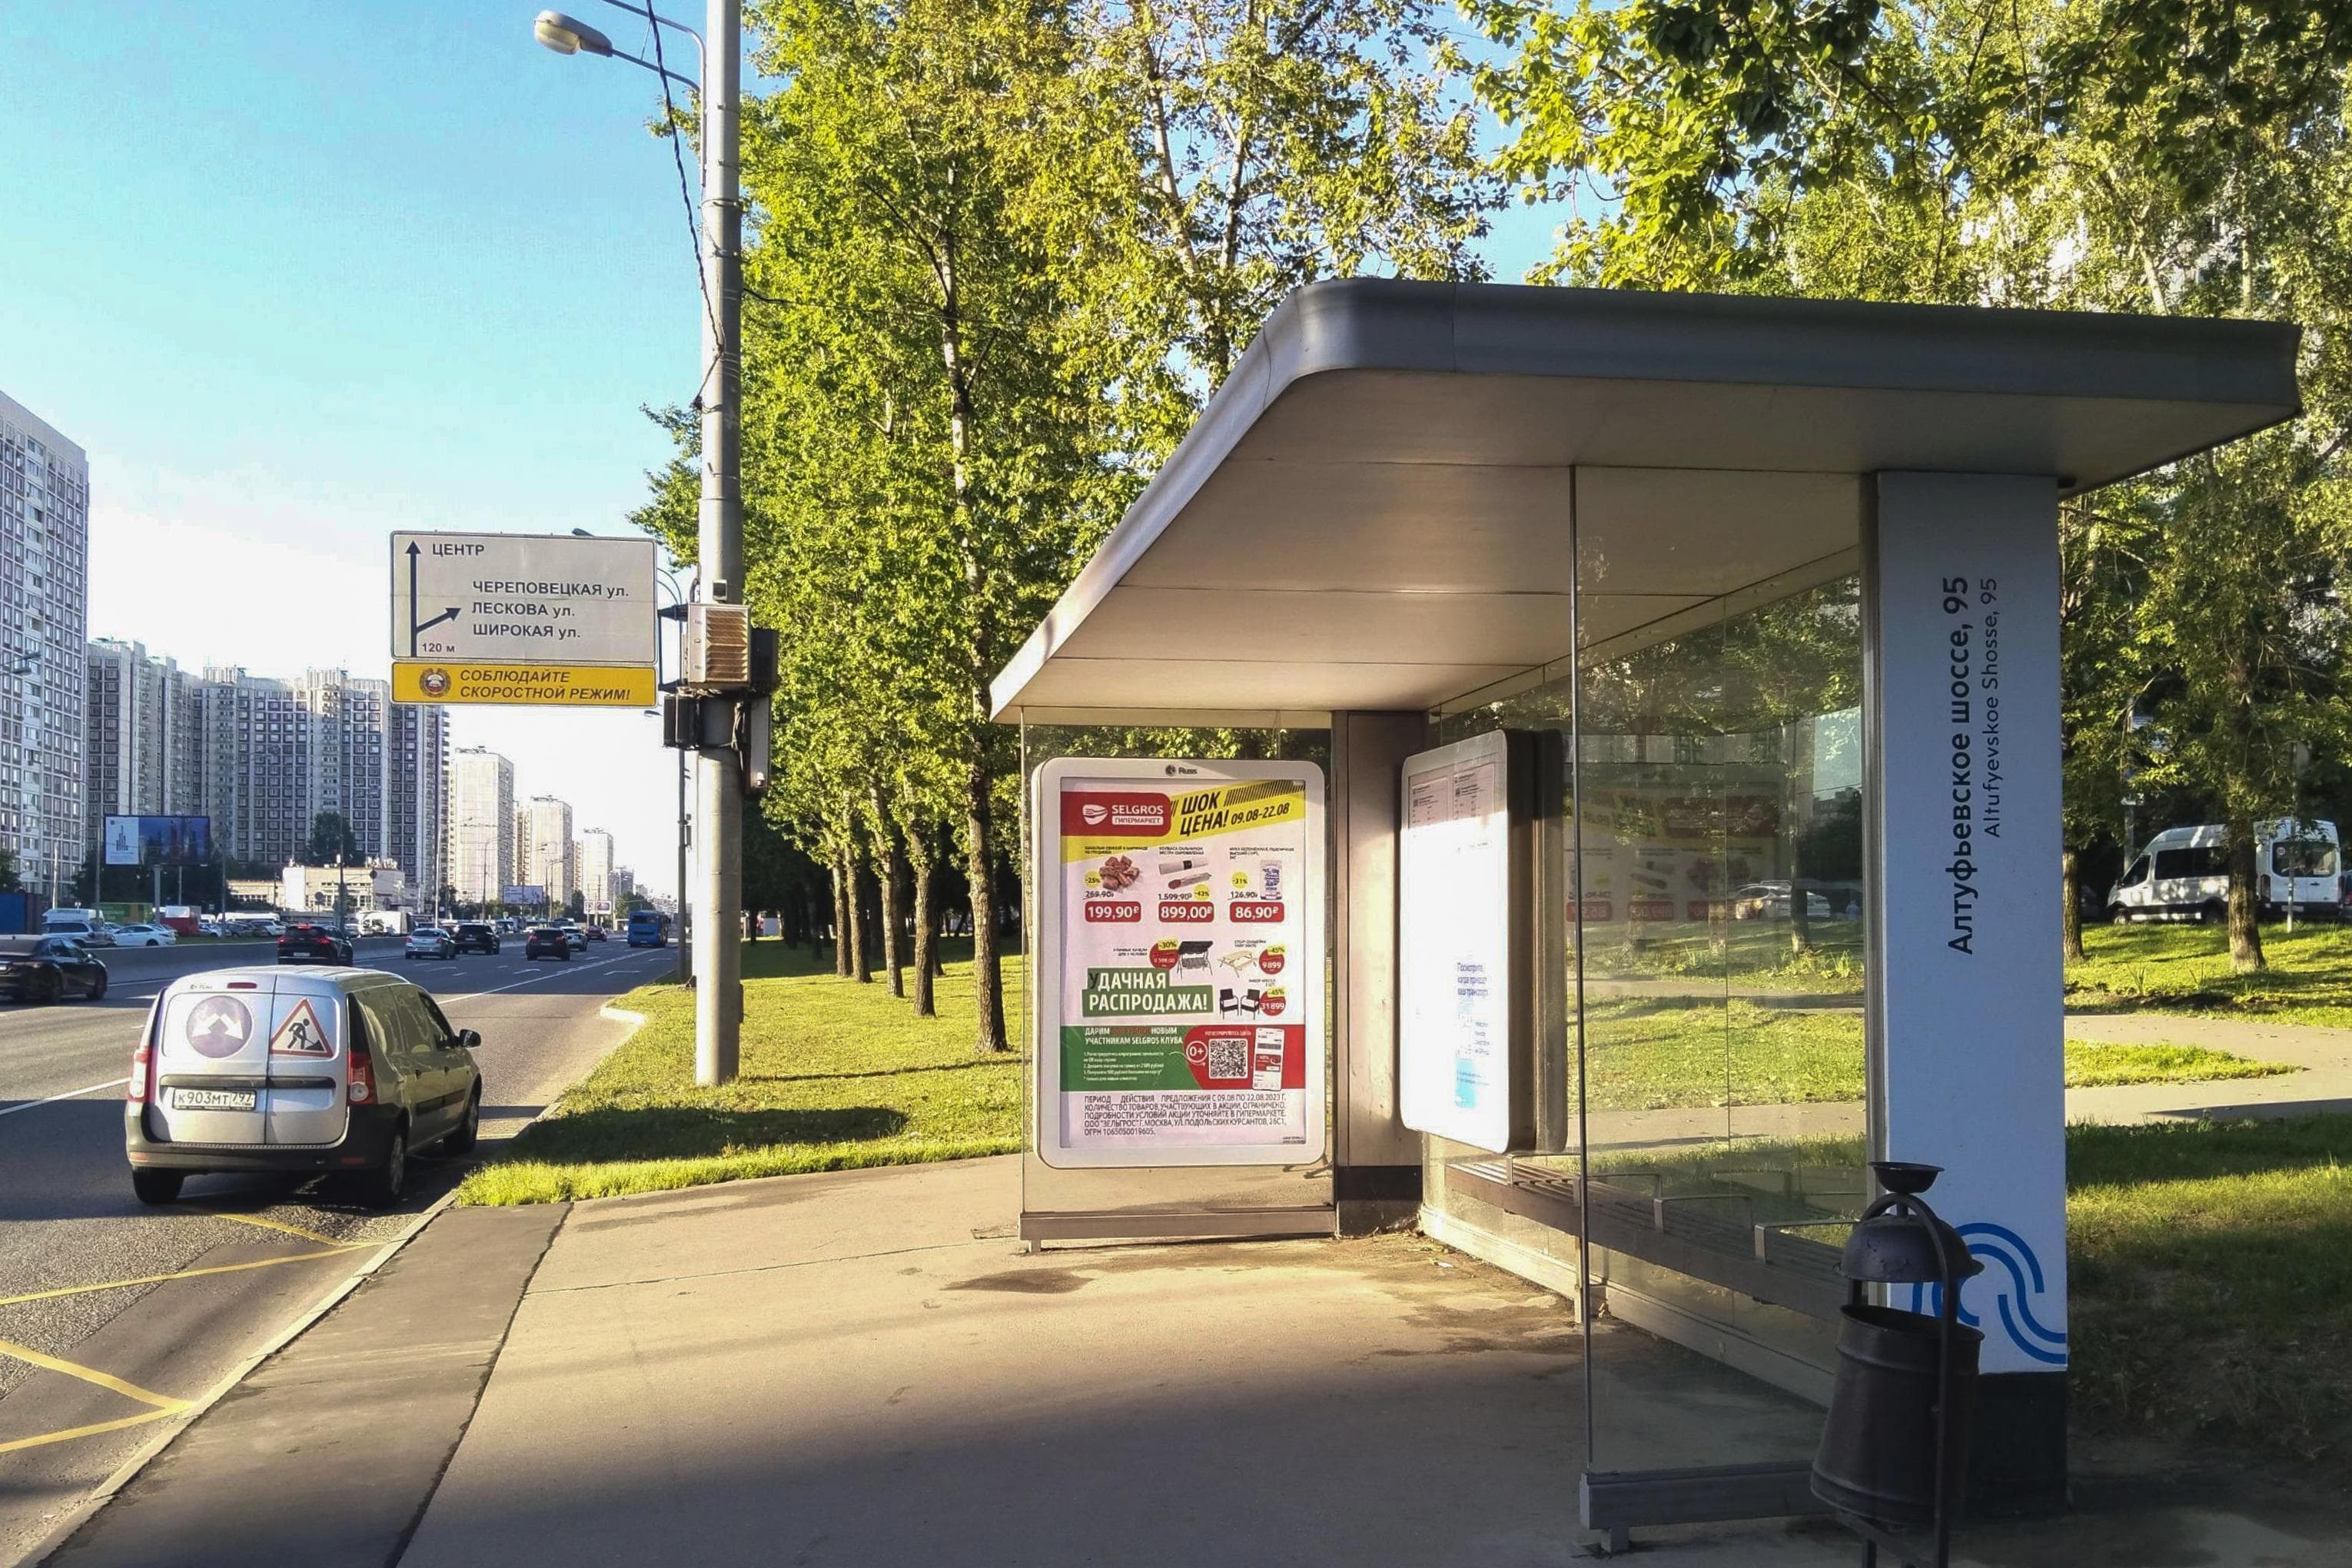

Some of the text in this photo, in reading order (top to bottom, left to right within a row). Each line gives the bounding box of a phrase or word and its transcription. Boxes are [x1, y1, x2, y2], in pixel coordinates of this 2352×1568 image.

[432, 543, 485, 556] ЦЕНТР
[473, 581, 630, 599] ЧЕРЕПОВЕЦКАЯ ул.
[472, 602, 576, 619] ЛЕСКОВА ул.
[473, 624, 581, 640] ШИРОКАЯ ул.
[422, 643, 443, 653] 120
[460, 669, 571, 684] СОБЛЮДАЙТЕ
[460, 684, 631, 700] СКОРОСТНОЙ РЕЖИМ!
[1980, 578, 2003, 839] Altufyevskoe Shosse, 95
[1943, 576, 1978, 955] Алтуфьевское шоссе, 95
[1111, 805, 1164, 815] SELGROS
[1181, 791, 1221, 815] ШОК
[1180, 802, 1291, 837] ЦЕНА! 09.08-22.08
[1159, 940, 1178, 949] -30%
[1088, 972, 1166, 992] УДАЧНАЯ
[1089, 993, 1208, 1013] РАСПРОДАЖА!
[1085, 1027, 1111, 1035] ДАРИМ
[1085, 1036, 1184, 1045] УЧАСТНИКАМ SELGROS КЛУБА
[1085, 1095, 1111, 1104] ПЕРИОД
[1121, 1095, 1154, 1104] ДЕЙСТВИЯ
[1085, 1103, 1128, 1111] КОЛИЧЕСТВО
[1135, 1110, 1167, 1119] УСЛОВИЙ
[1168, 1111, 1191, 1119] АКЦИИ
[1236, 1109, 1287, 1118] ГИПЕРМАРКЕТЕ.
